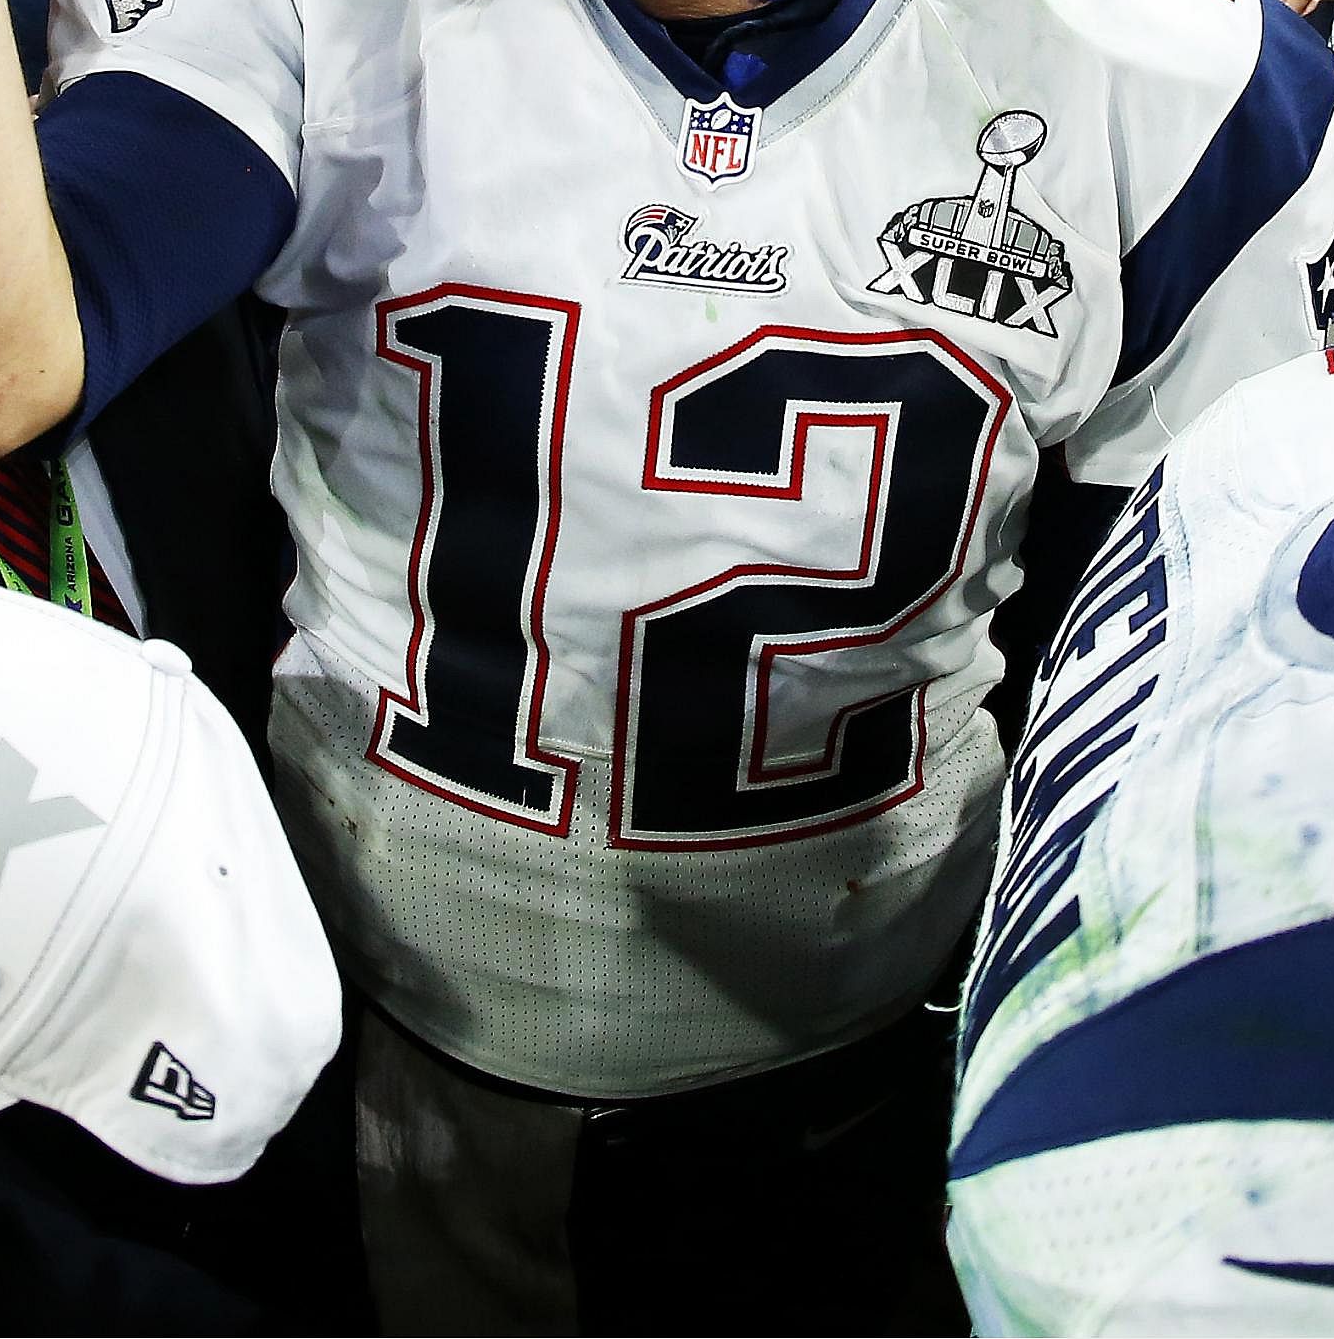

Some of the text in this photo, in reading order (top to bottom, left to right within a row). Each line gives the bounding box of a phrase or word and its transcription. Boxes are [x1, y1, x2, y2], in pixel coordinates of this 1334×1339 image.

[689, 133, 742, 173] NFL
[623, 223, 789, 290] Patriots
[919, 233, 1037, 275] SUPER BOWL
[866, 238, 1073, 339] XLIX
[65, 536, 77, 592] ARIZONA
[367, 281, 1013, 852] 12
